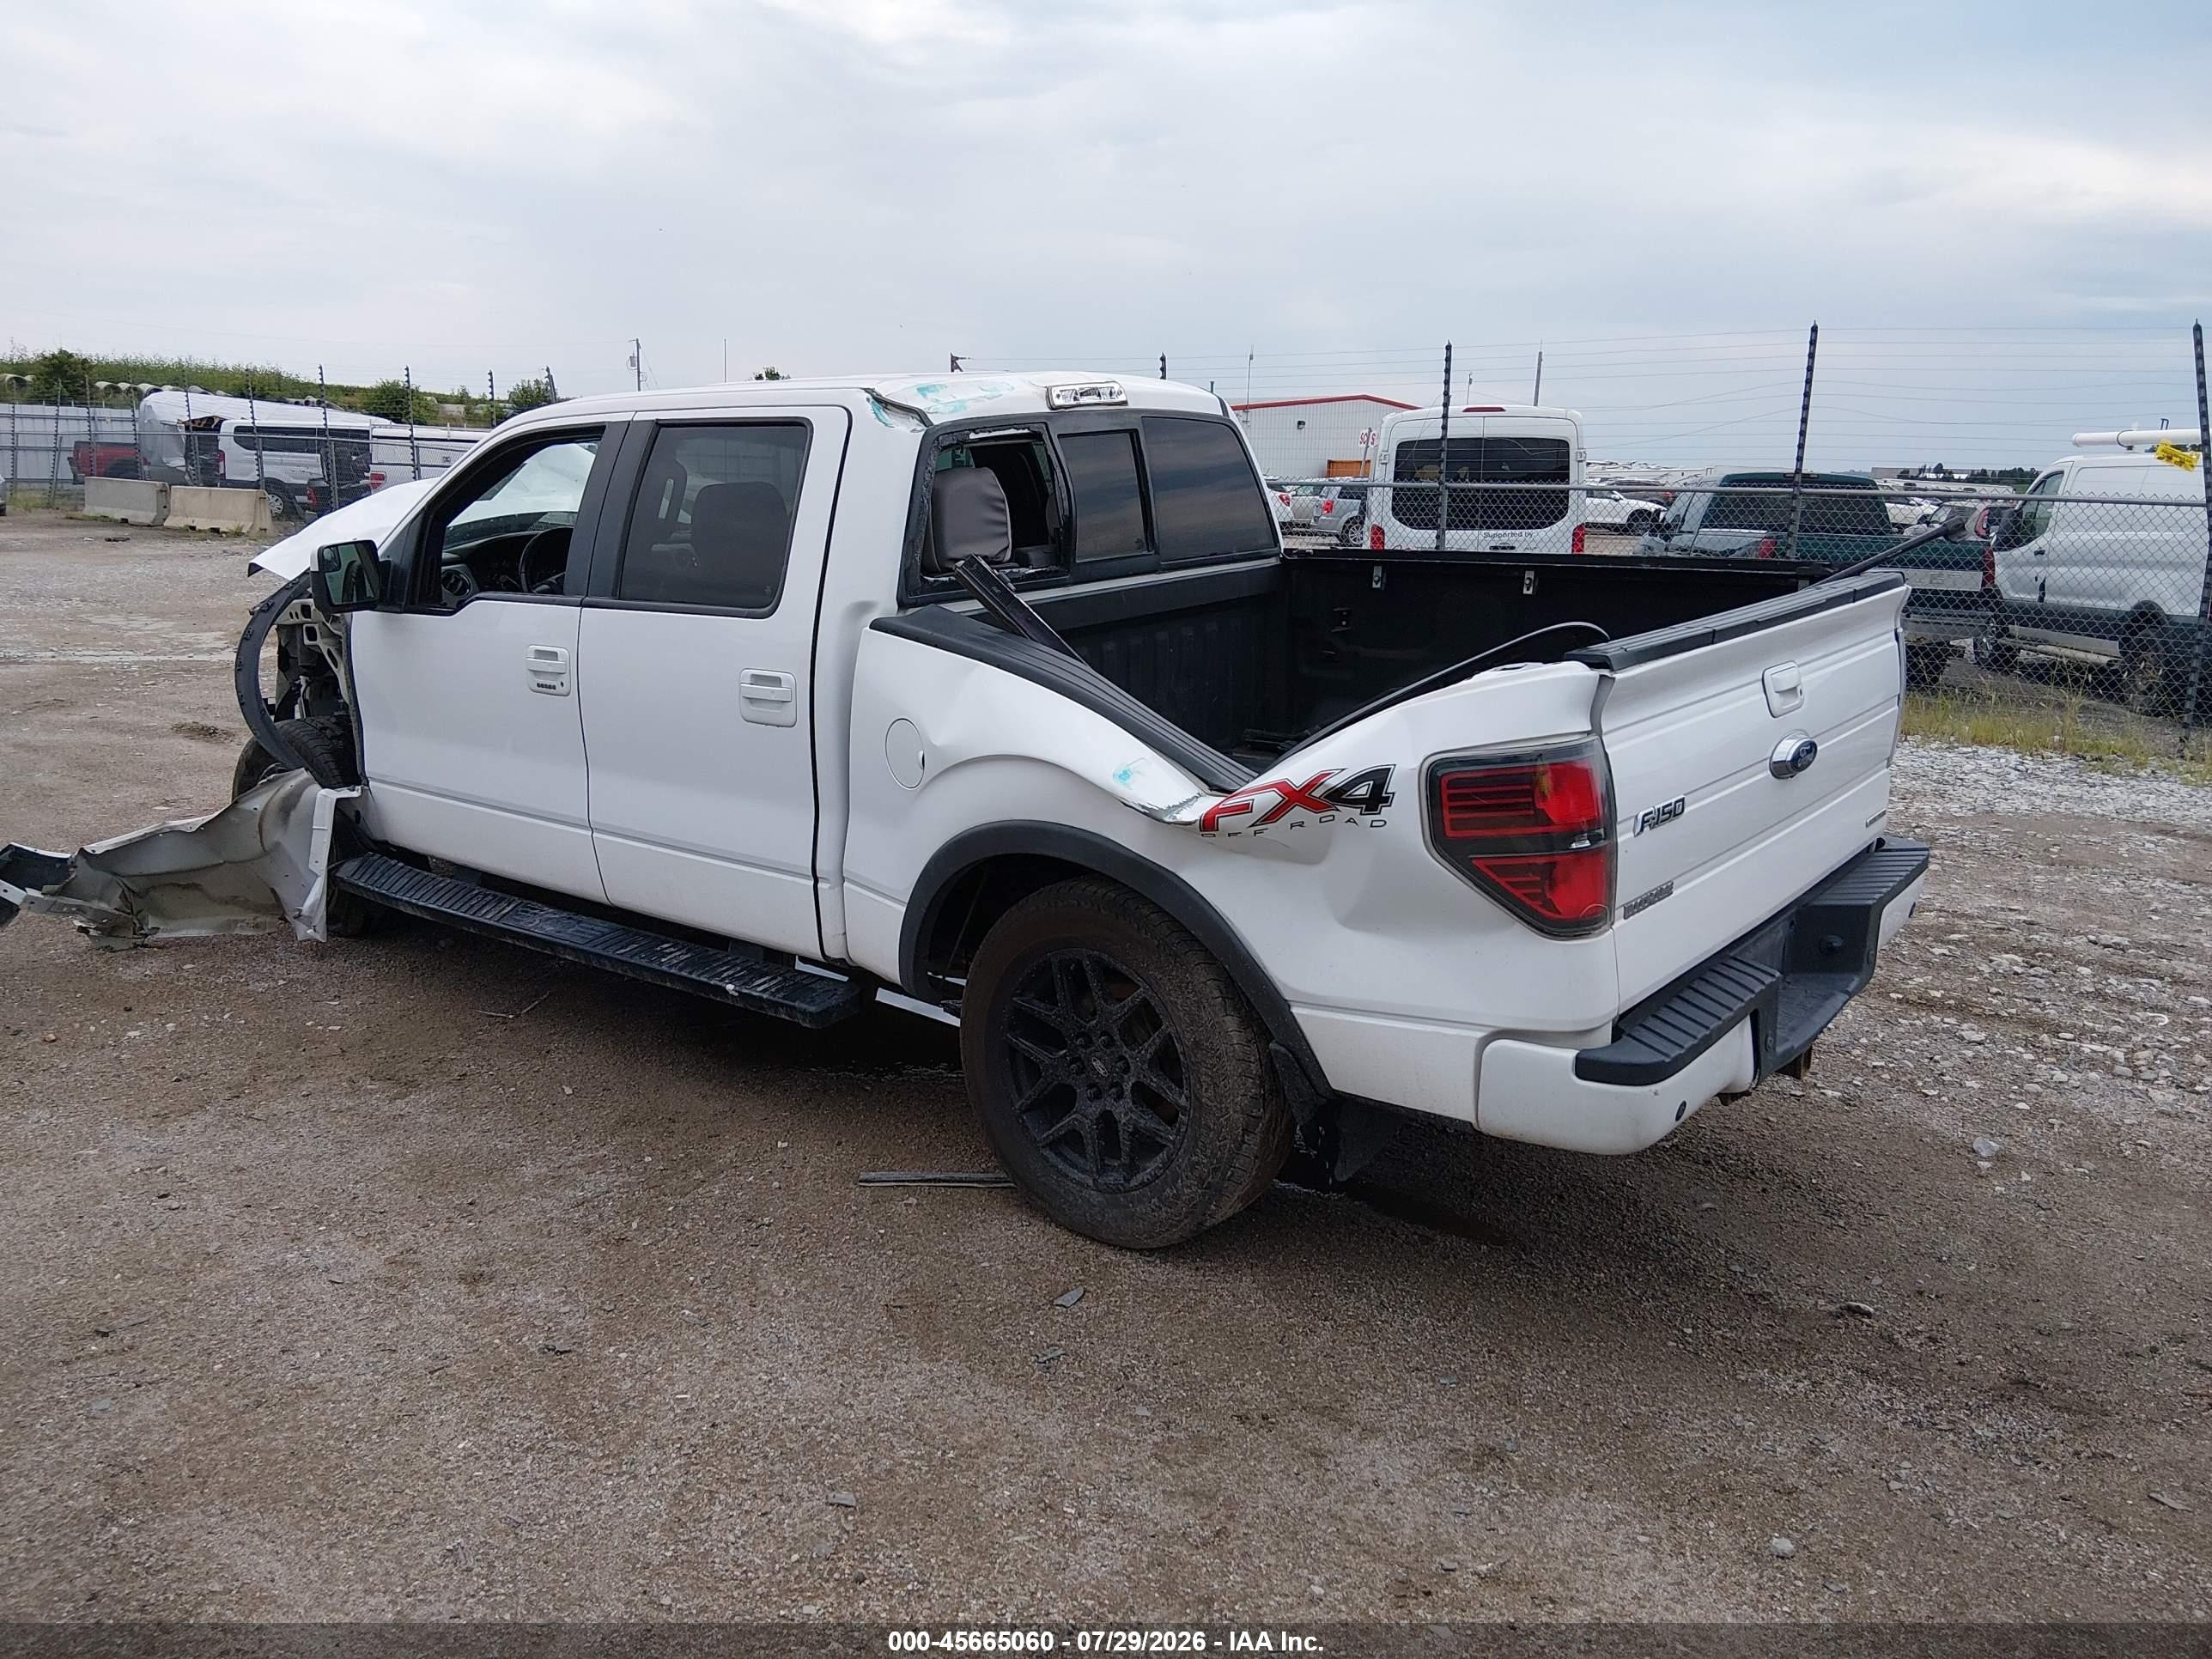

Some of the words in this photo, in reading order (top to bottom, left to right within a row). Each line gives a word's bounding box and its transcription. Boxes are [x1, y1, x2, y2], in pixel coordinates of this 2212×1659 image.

[1199, 763, 1396, 832] FX4
[1201, 827, 1268, 838] OFF
[1289, 814, 1387, 830] ROAD
